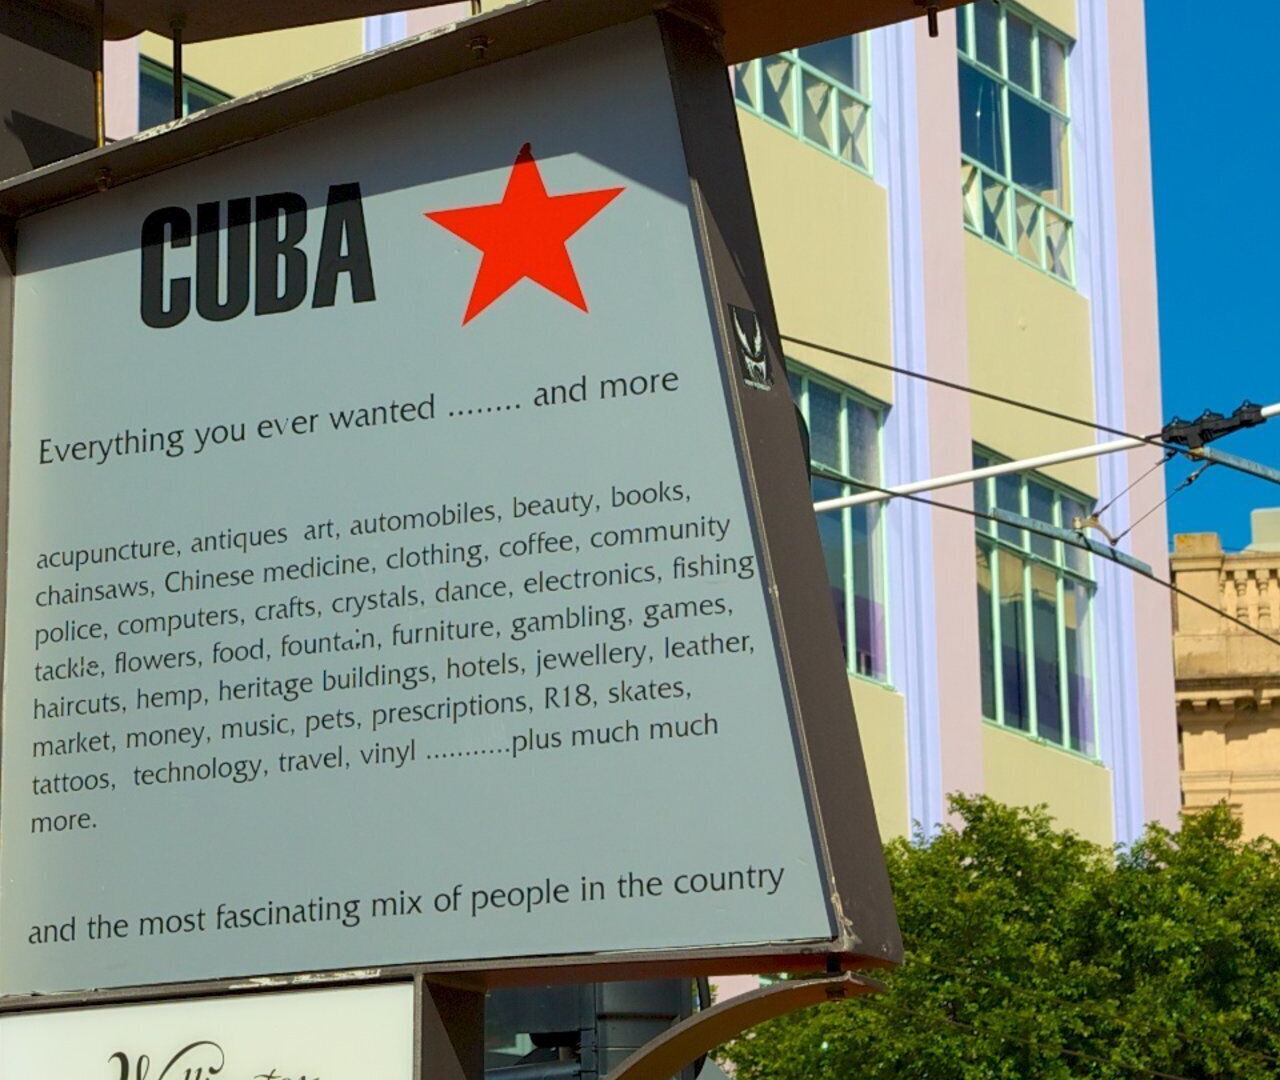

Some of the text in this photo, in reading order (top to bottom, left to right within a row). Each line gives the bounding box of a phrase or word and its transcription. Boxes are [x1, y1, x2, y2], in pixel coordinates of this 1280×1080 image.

[141, 182, 376, 329] CUBA
[39, 427, 185, 466] Everything
[193, 422, 246, 455] you
[256, 413, 320, 439] ever
[328, 392, 435, 431] wanted
[533, 374, 587, 408] and
[600, 371, 680, 400] more
[35, 515, 731, 608] chainsaws, Chinese medicine, clothing, coffee, community
[36, 480, 691, 572] acupuncture, antiques art, automobiles, beauty, books,
[34, 597, 733, 682] tackle, flowers, food, fountain, furniture, gambling, games,
[35, 552, 755, 651] police, computers, crafts, crystals, dance, electronics, fishing
[32, 679, 692, 758] market, money, music, pets, prescriptions, R18, skates,
[33, 632, 755, 720] haircuts, hemp, heritage buildings, hotels, jewellery, leather,
[31, 772, 116, 796] tattoos,
[133, 756, 269, 787] technology,
[278, 744, 350, 773] travel,
[359, 738, 416, 769] vinyl
[571, 719, 640, 747] much
[649, 712, 719, 740] much
[31, 812, 97, 834] more.
[27, 864, 785, 945] and the most fascinating mix of people in the country
